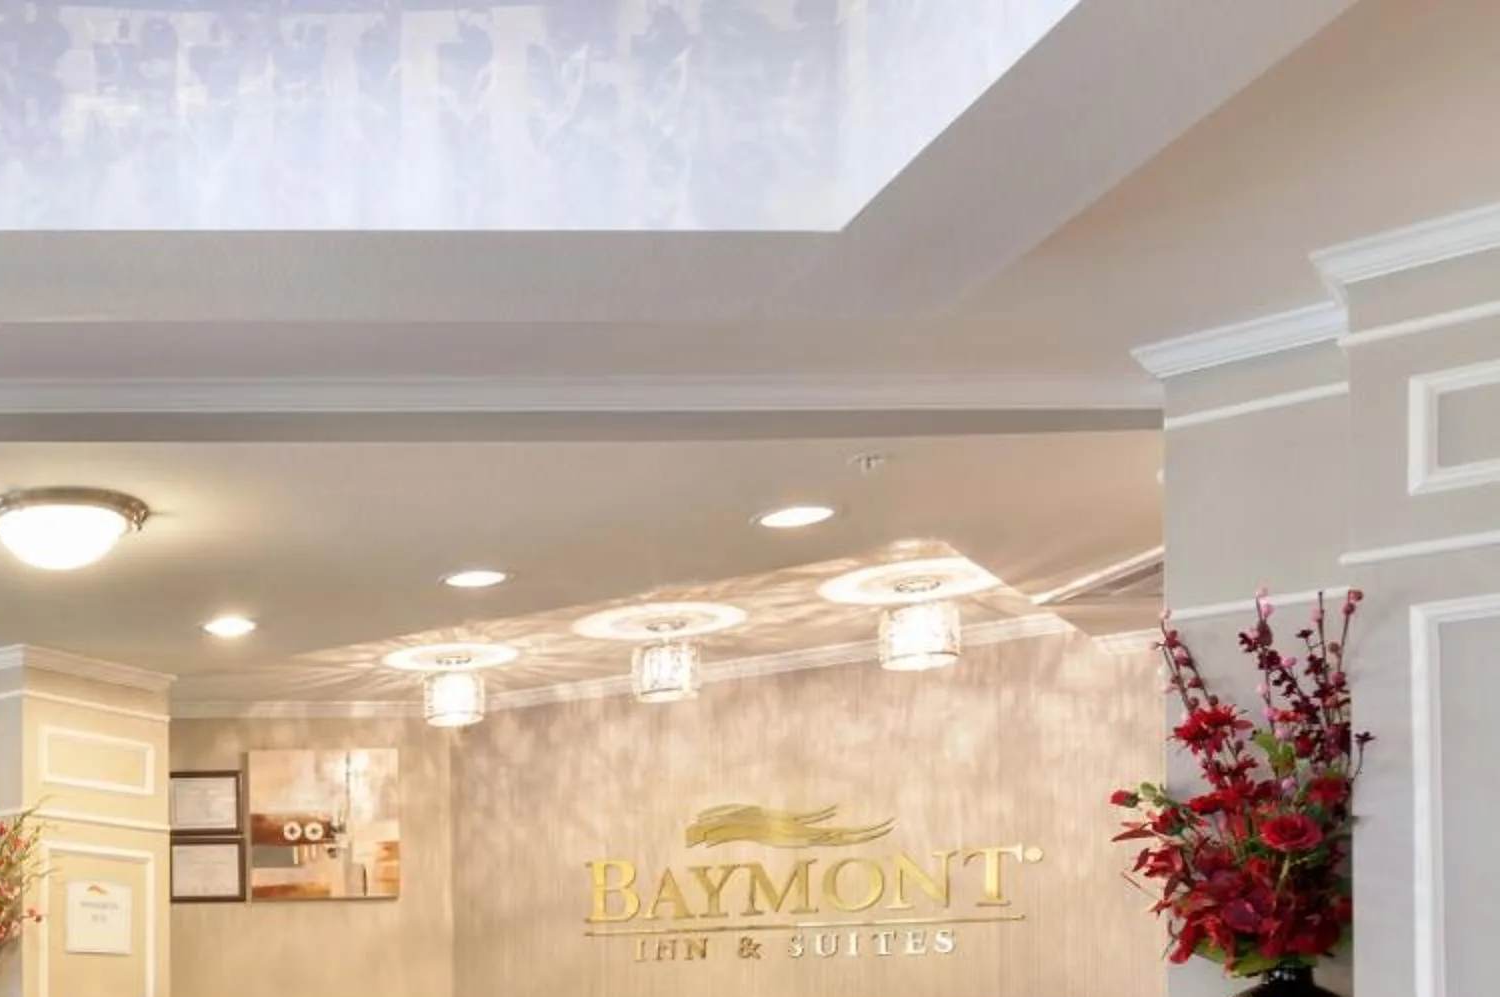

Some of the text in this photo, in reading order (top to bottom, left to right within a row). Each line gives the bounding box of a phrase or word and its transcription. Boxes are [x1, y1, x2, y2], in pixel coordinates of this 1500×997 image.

[584, 843, 1024, 924] BAYMONT
[634, 927, 957, 963] INN & SUITES
